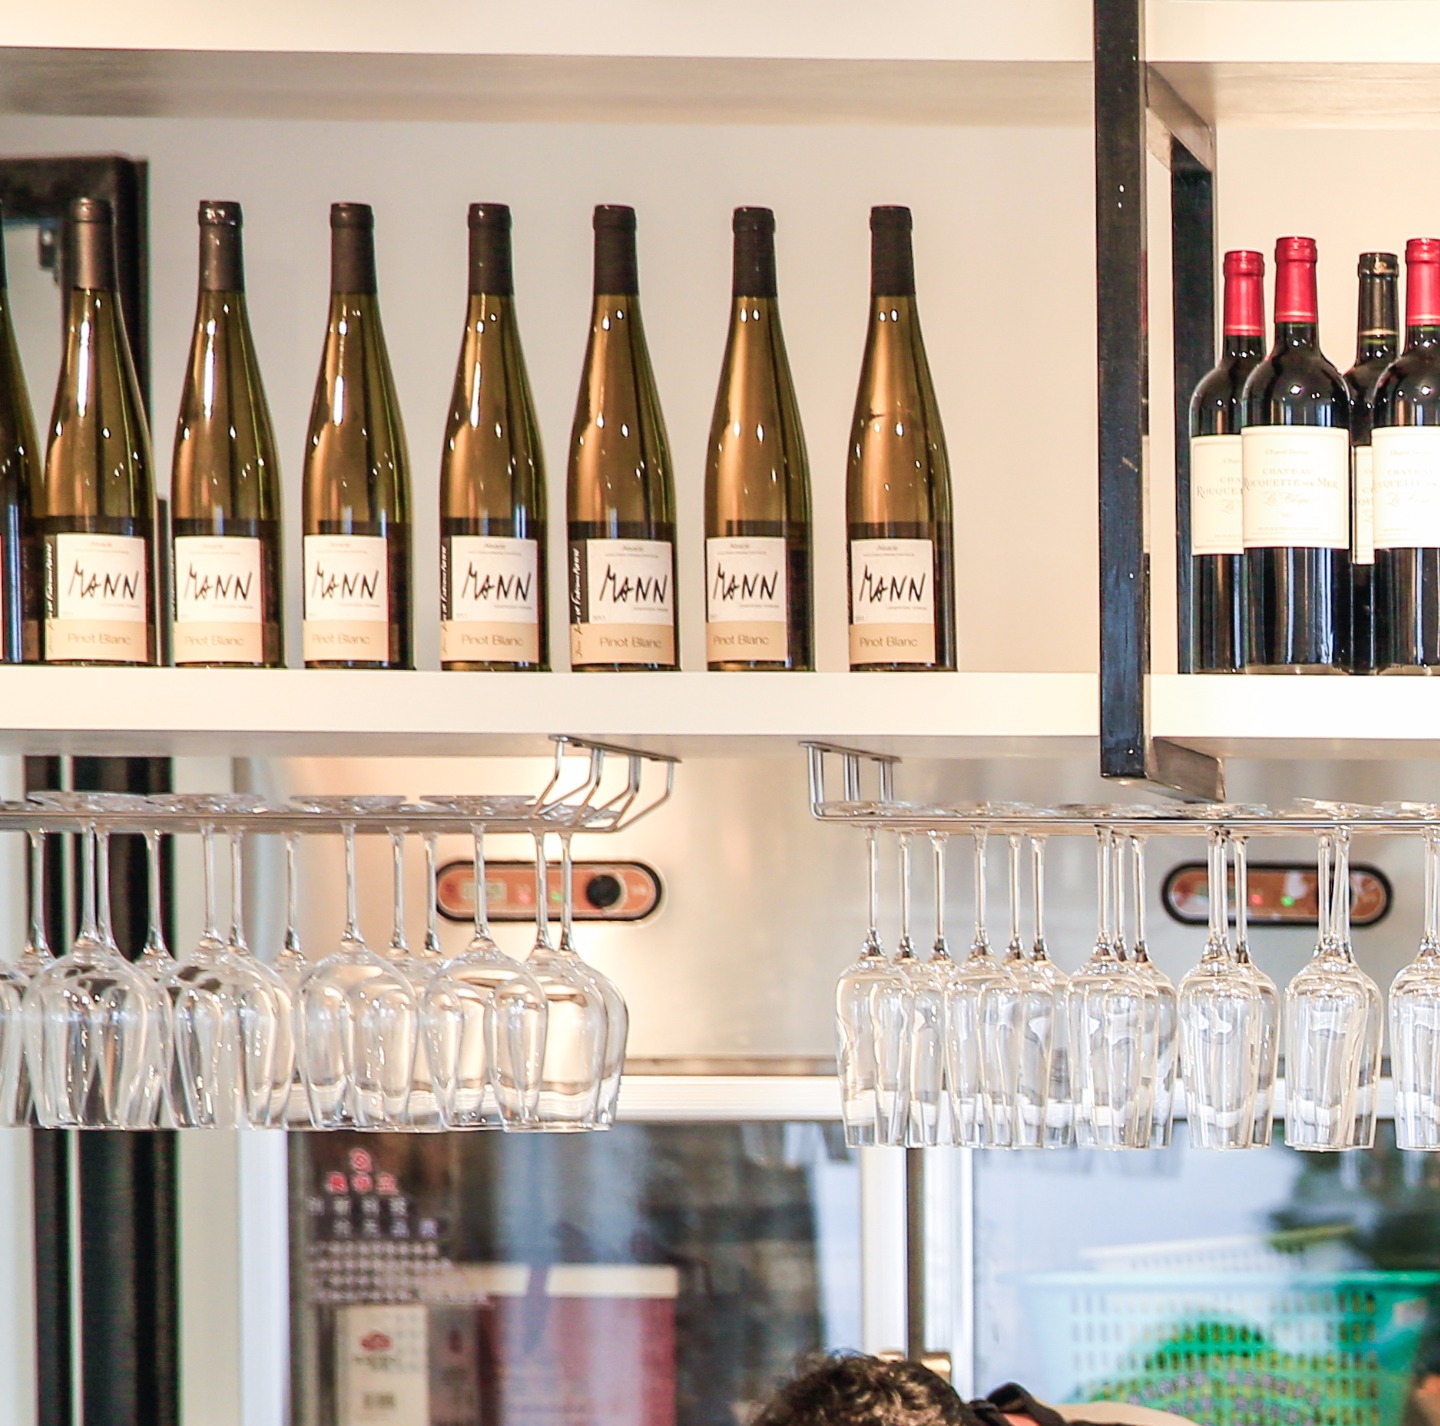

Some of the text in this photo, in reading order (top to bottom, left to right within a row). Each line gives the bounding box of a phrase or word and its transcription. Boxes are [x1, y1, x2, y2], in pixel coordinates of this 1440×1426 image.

[68, 633, 131, 646] Pinot Blanc
[184, 635, 245, 647] Pinot Blanc
[312, 634, 370, 646] Pinot Blanc
[461, 633, 524, 646] Pinot Blanc
[600, 636, 662, 649] Pinot Blanc
[713, 634, 770, 646] Pinot Blanc
[860, 635, 919, 648] Pinot Blanc
